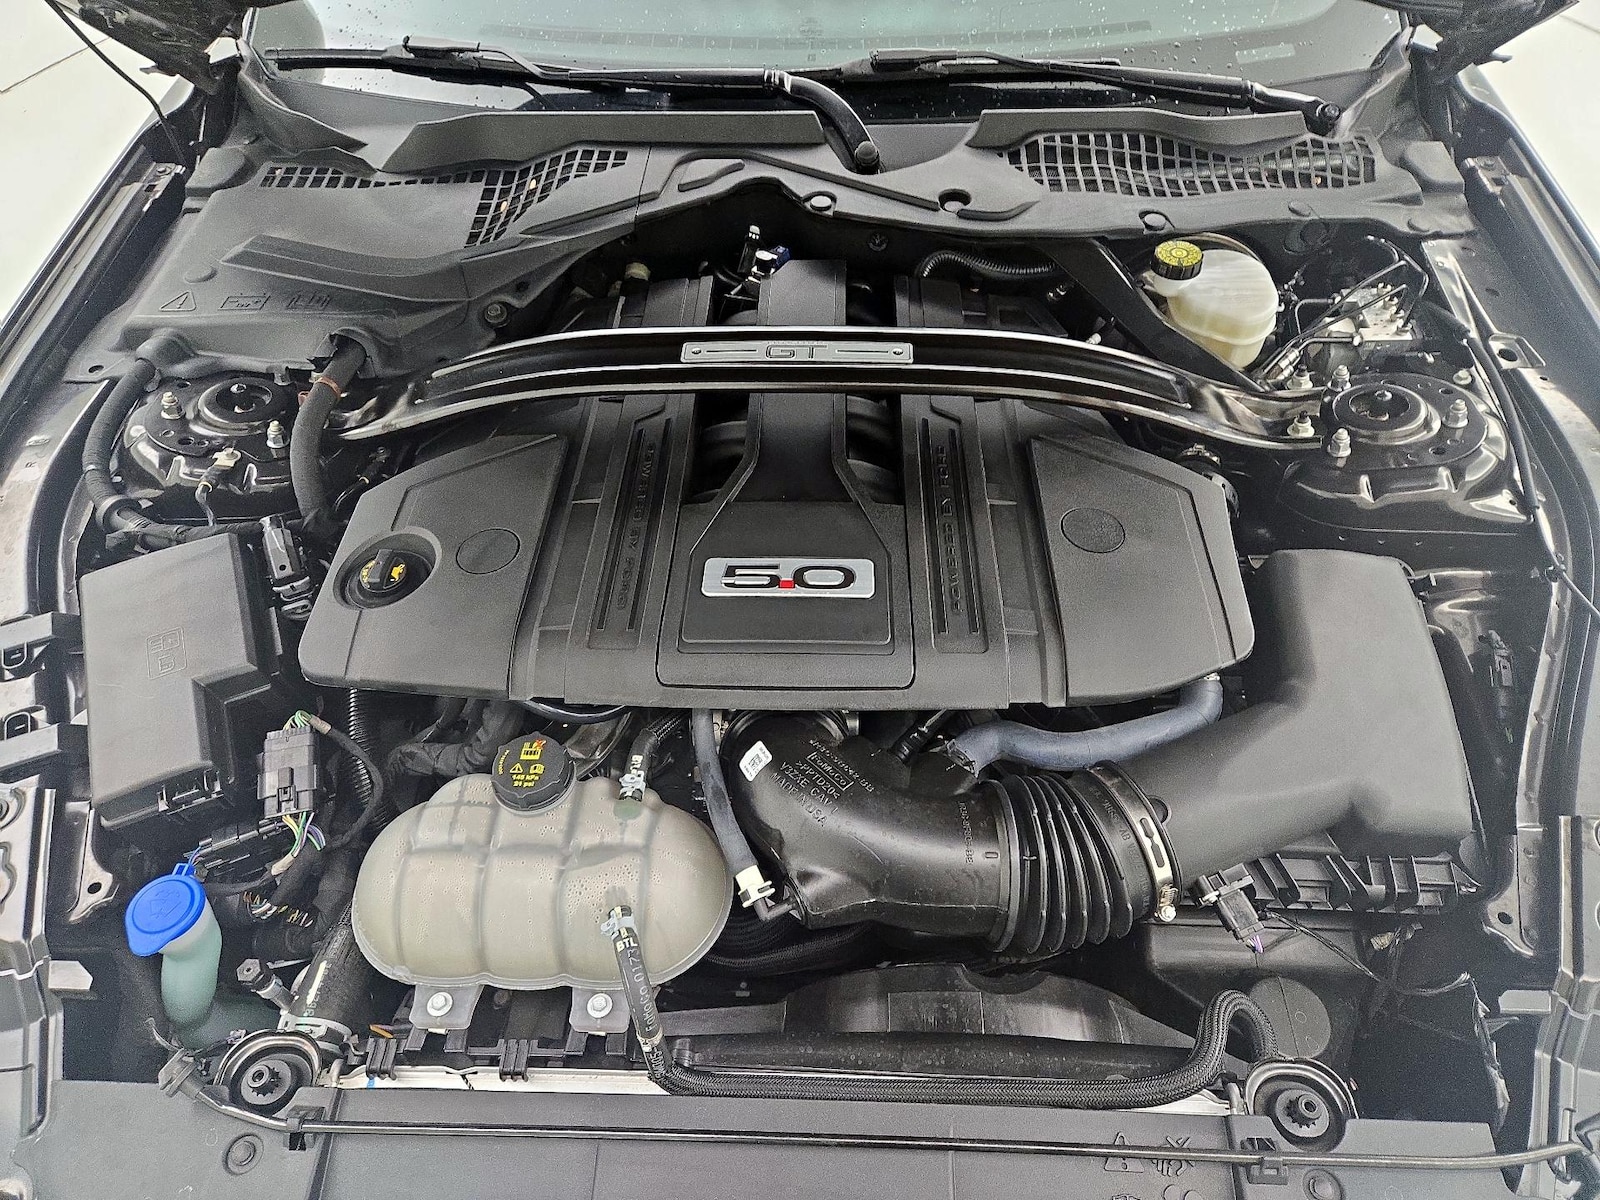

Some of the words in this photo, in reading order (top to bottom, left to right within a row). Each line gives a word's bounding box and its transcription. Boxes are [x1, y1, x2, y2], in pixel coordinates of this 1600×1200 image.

[765, 344, 828, 359] GT
[941, 497, 953, 518] BY
[720, 563, 857, 590] 5.0
[810, 752, 848, 787] FoMoCo
[769, 771, 799, 796] MADE
[806, 801, 828, 827] USA
[616, 936, 638, 953] BTL
[640, 985, 658, 1032] FoMoCo
